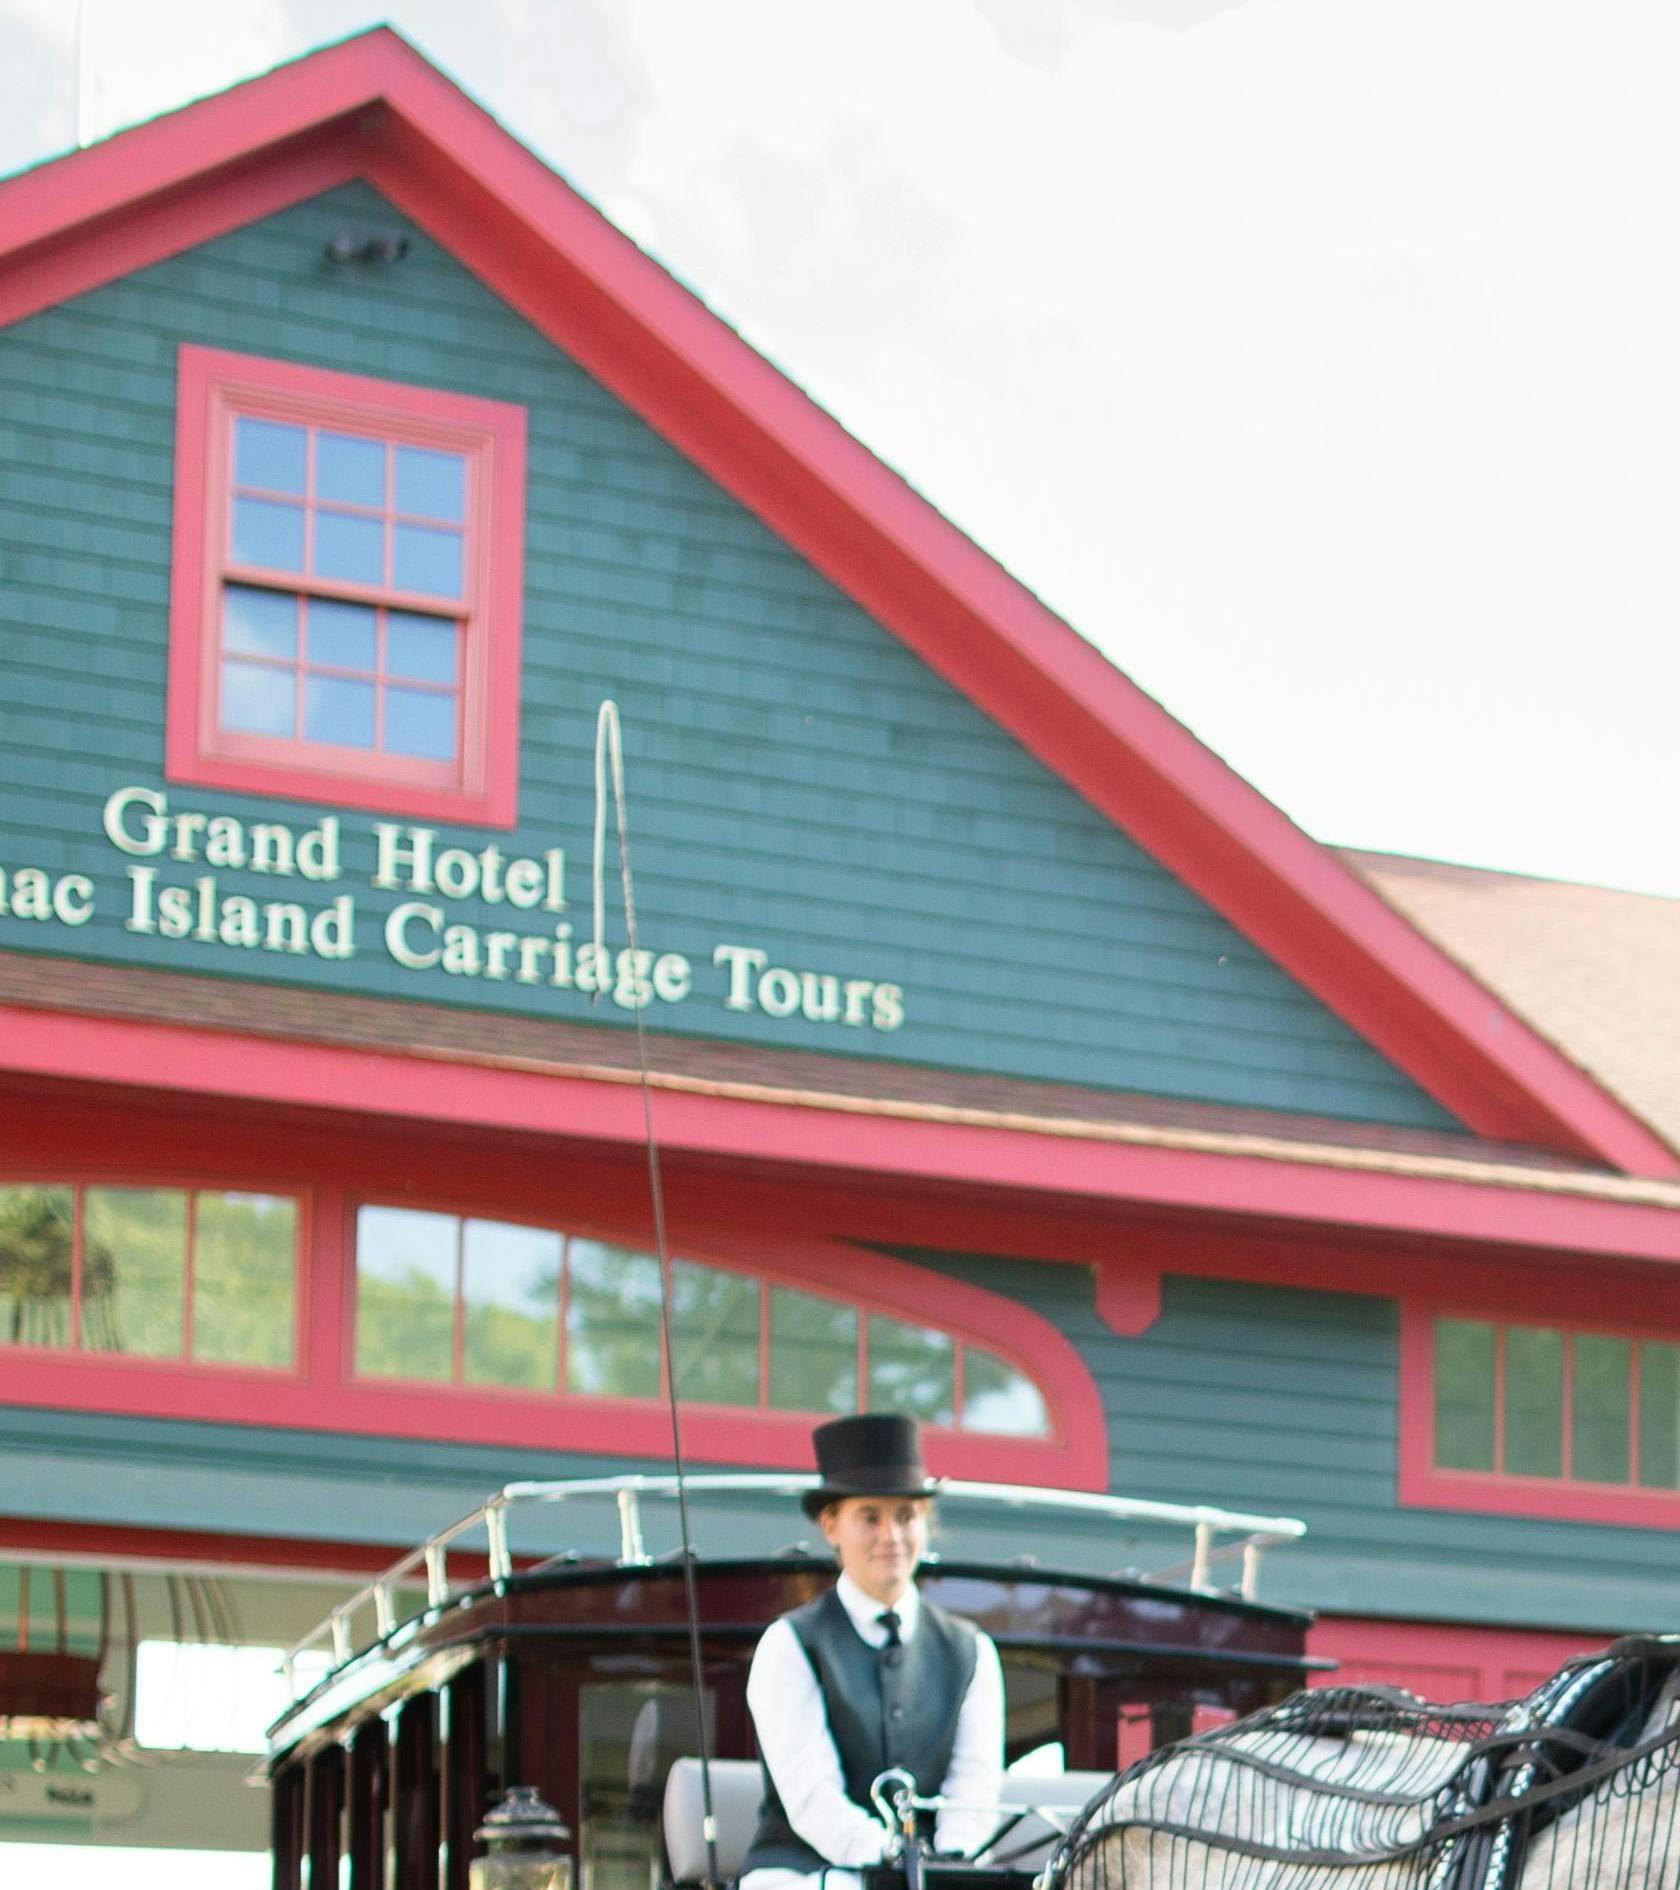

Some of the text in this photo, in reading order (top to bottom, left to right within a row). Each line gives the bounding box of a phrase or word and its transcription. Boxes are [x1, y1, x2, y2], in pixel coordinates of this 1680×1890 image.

[102, 785, 566, 912] Grand Hotel
[126, 864, 356, 958] Island
[384, 901, 691, 1009] Carriage
[712, 943, 905, 1031] Tours
